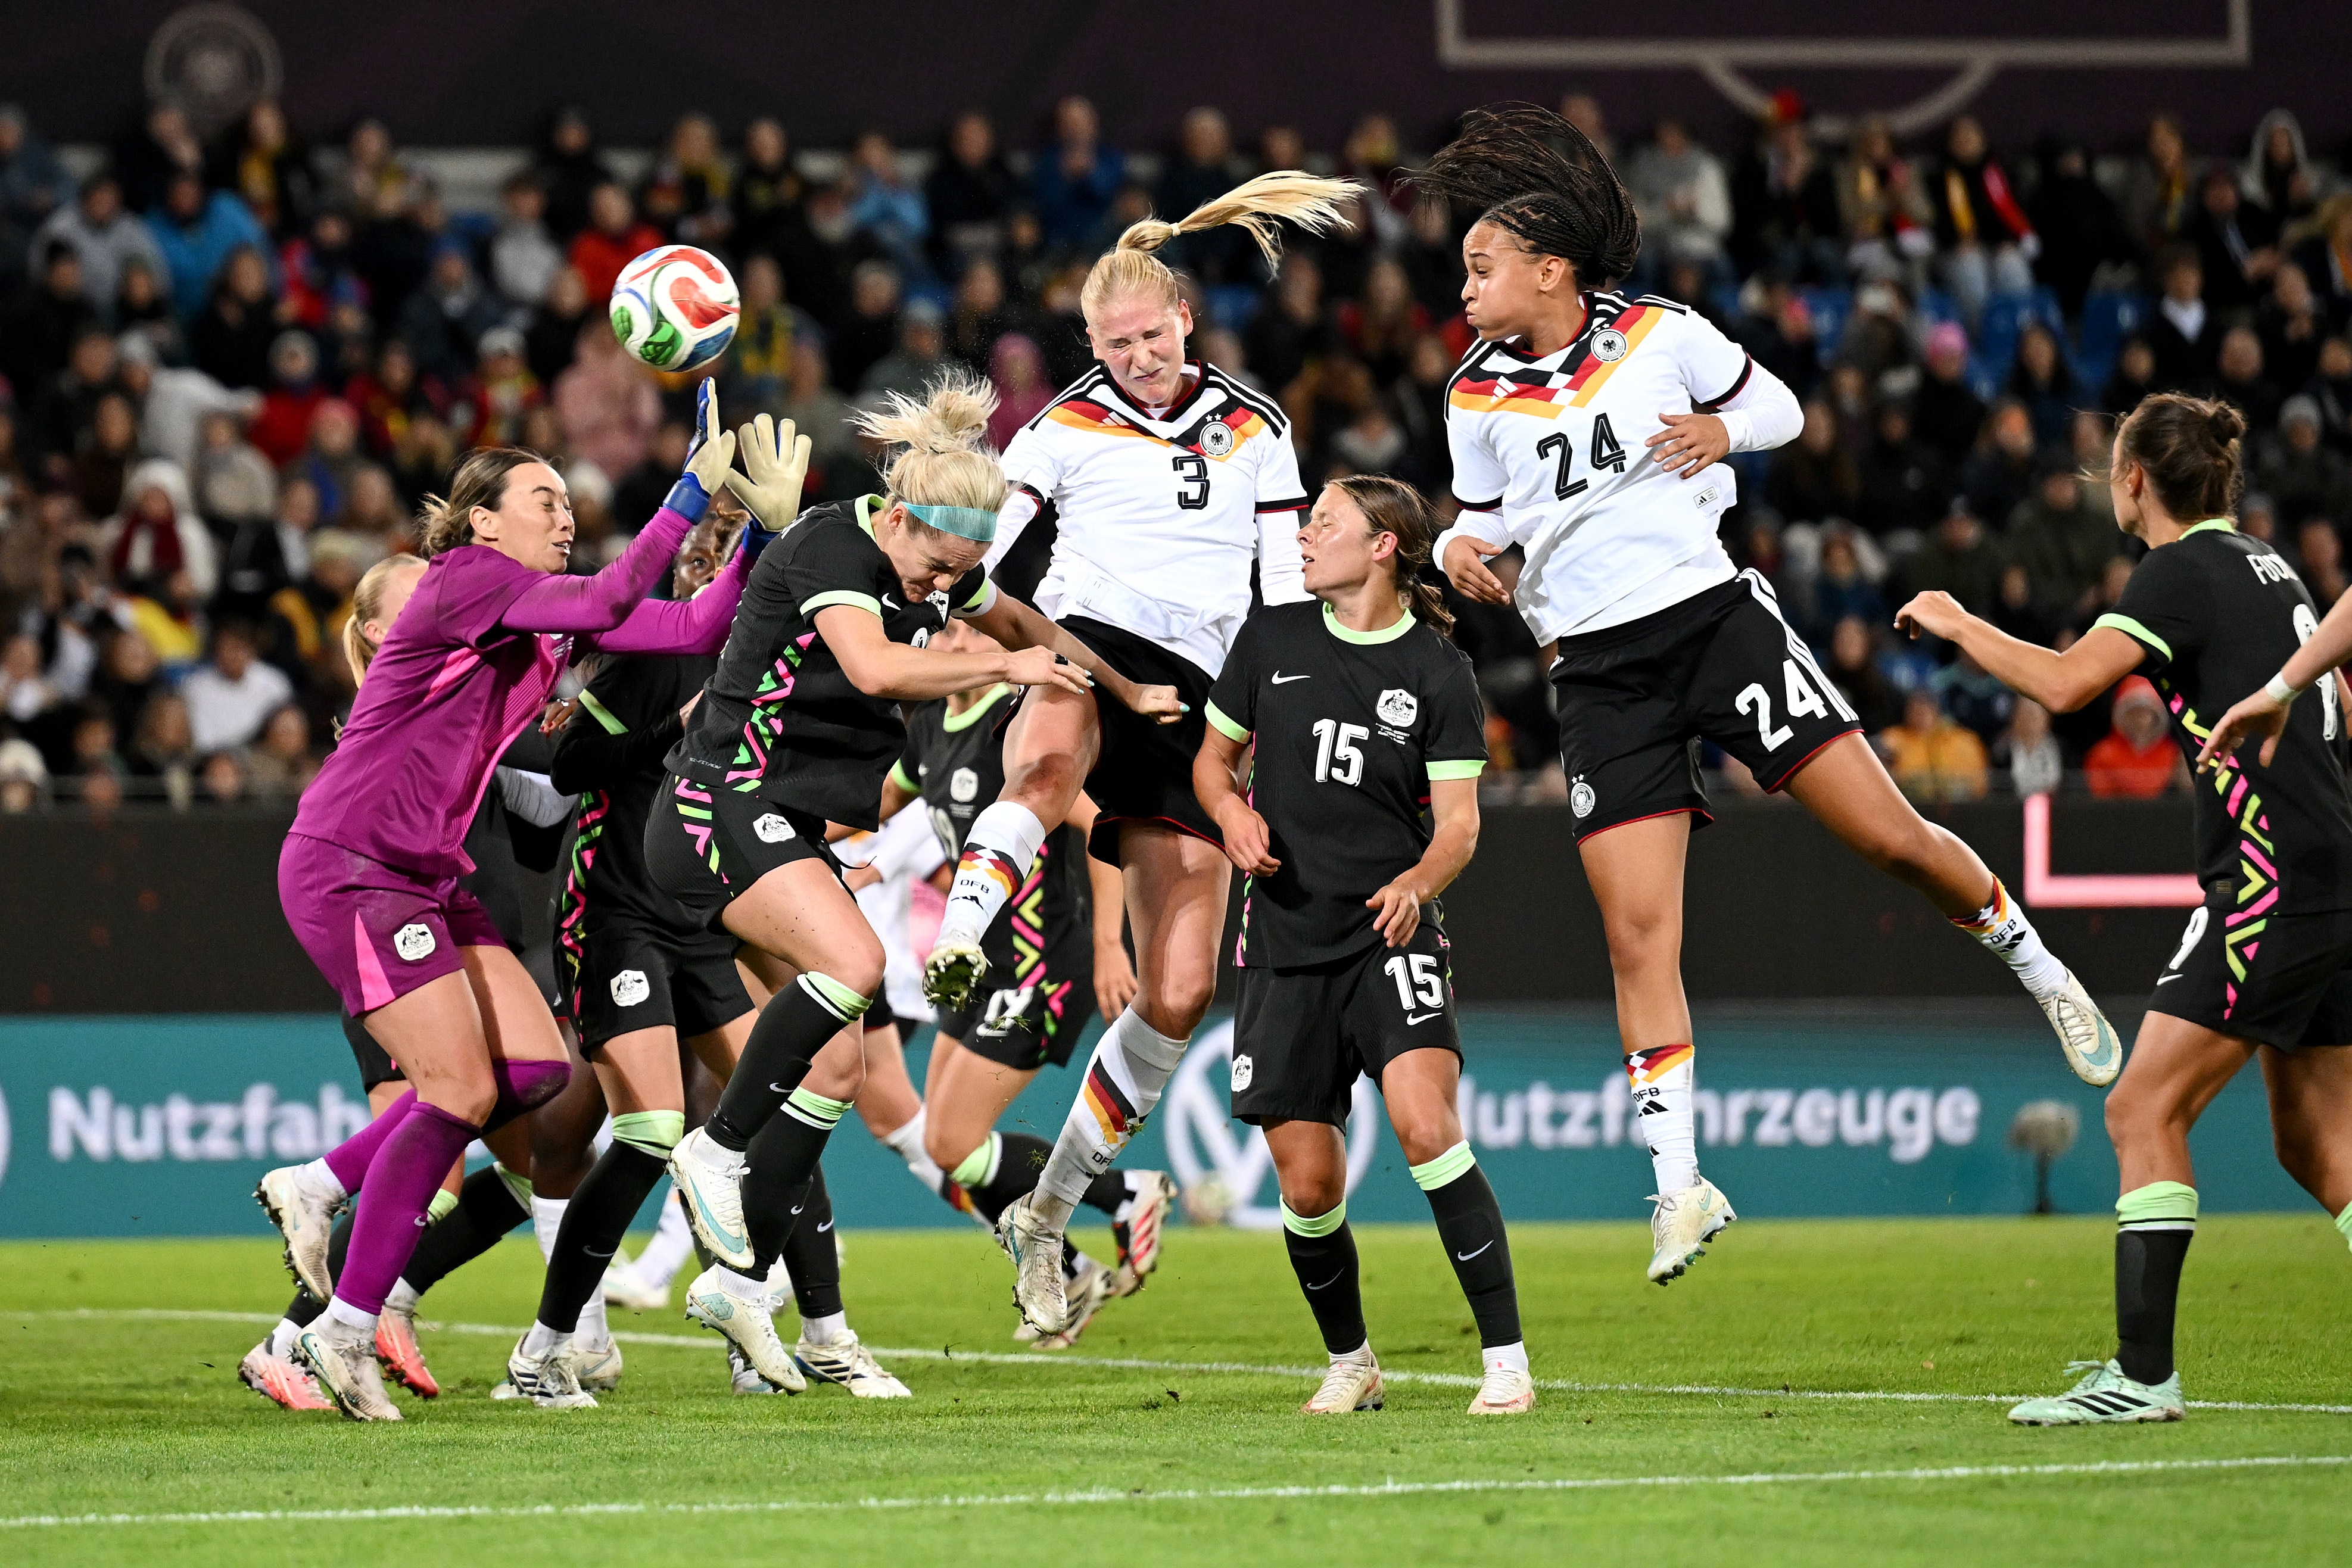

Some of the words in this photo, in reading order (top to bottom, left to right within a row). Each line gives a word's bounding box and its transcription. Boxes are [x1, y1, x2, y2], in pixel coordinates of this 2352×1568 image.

[1172, 454, 1210, 510] 3
[1536, 413, 1627, 501] 24
[2246, 553, 2300, 585] FOO
[1735, 658, 1829, 753] 24
[1312, 718, 1370, 787] 15
[961, 879, 989, 894] DFB
[1989, 919, 2017, 944] DFB
[1384, 953, 1444, 1011] 15
[48, 1083, 372, 1161] Nutzfah
[1458, 1070, 1982, 1164] utzfrzeuge
[1633, 1087, 1660, 1102] DFB
